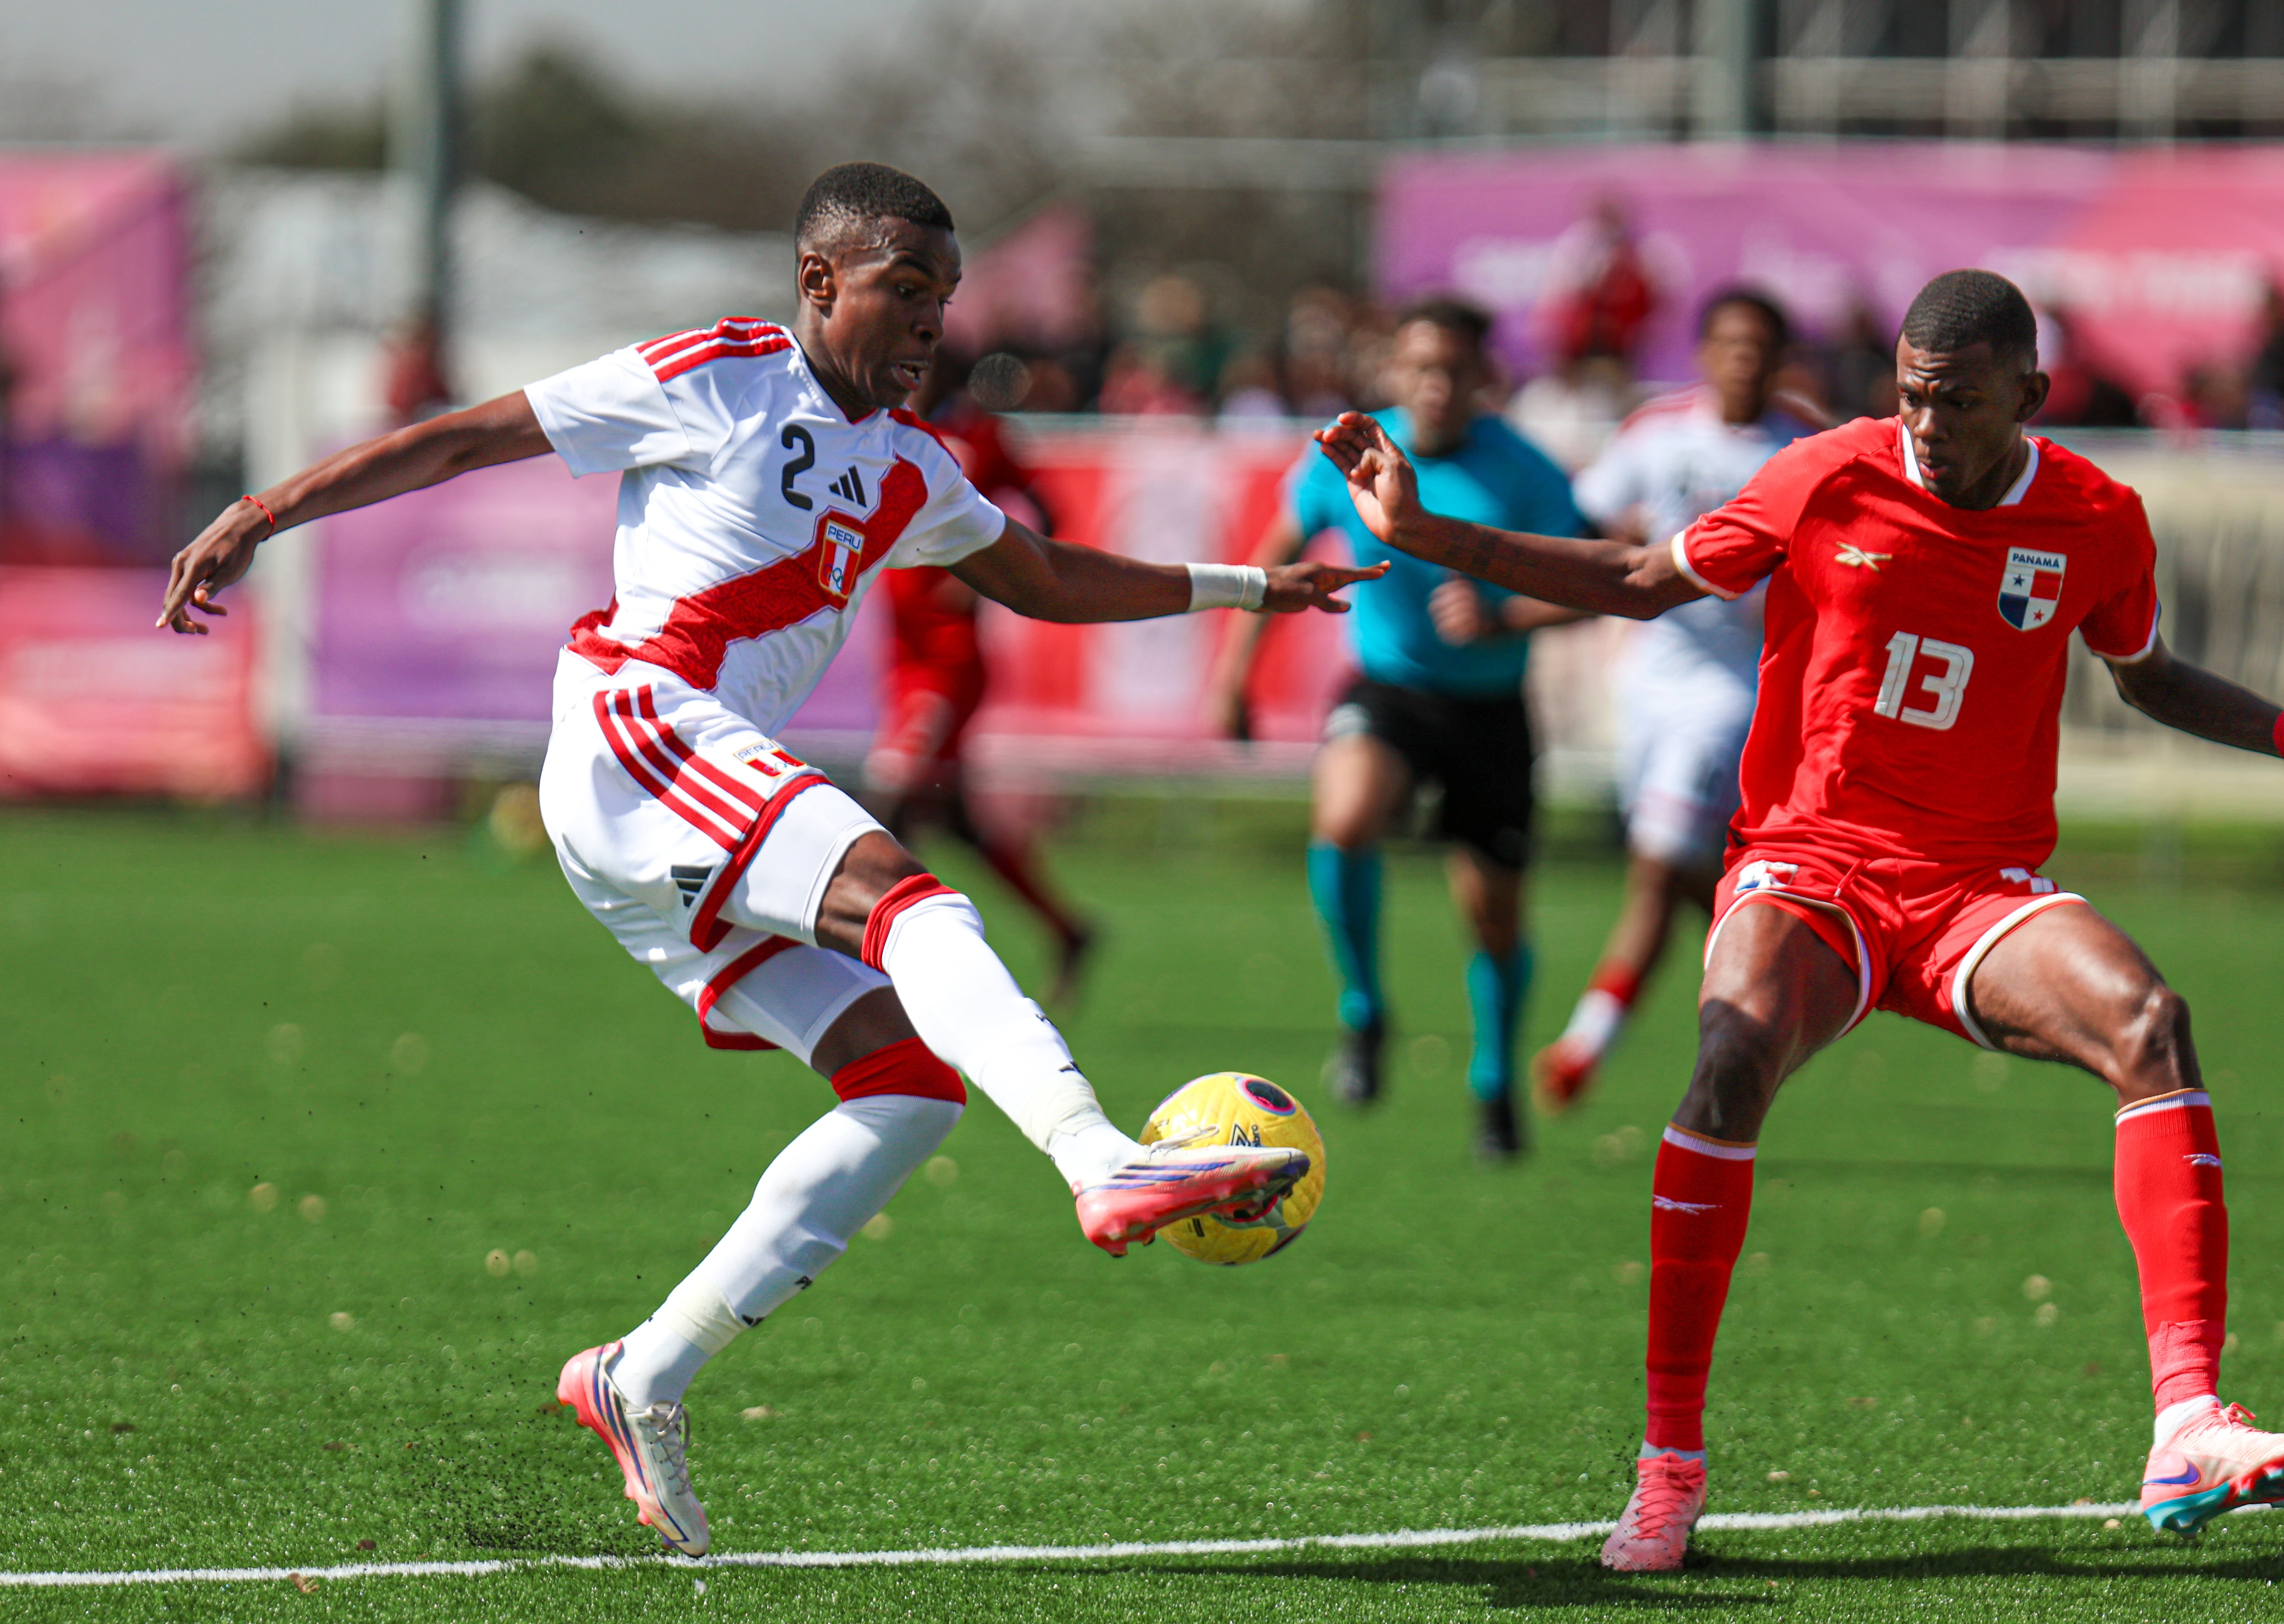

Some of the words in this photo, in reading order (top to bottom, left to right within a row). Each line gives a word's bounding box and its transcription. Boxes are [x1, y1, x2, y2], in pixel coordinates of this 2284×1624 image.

[782, 423, 815, 511] 2
[828, 525, 861, 550] PERU
[1873, 630, 1975, 731] 13
[738, 741, 774, 759] PERU
